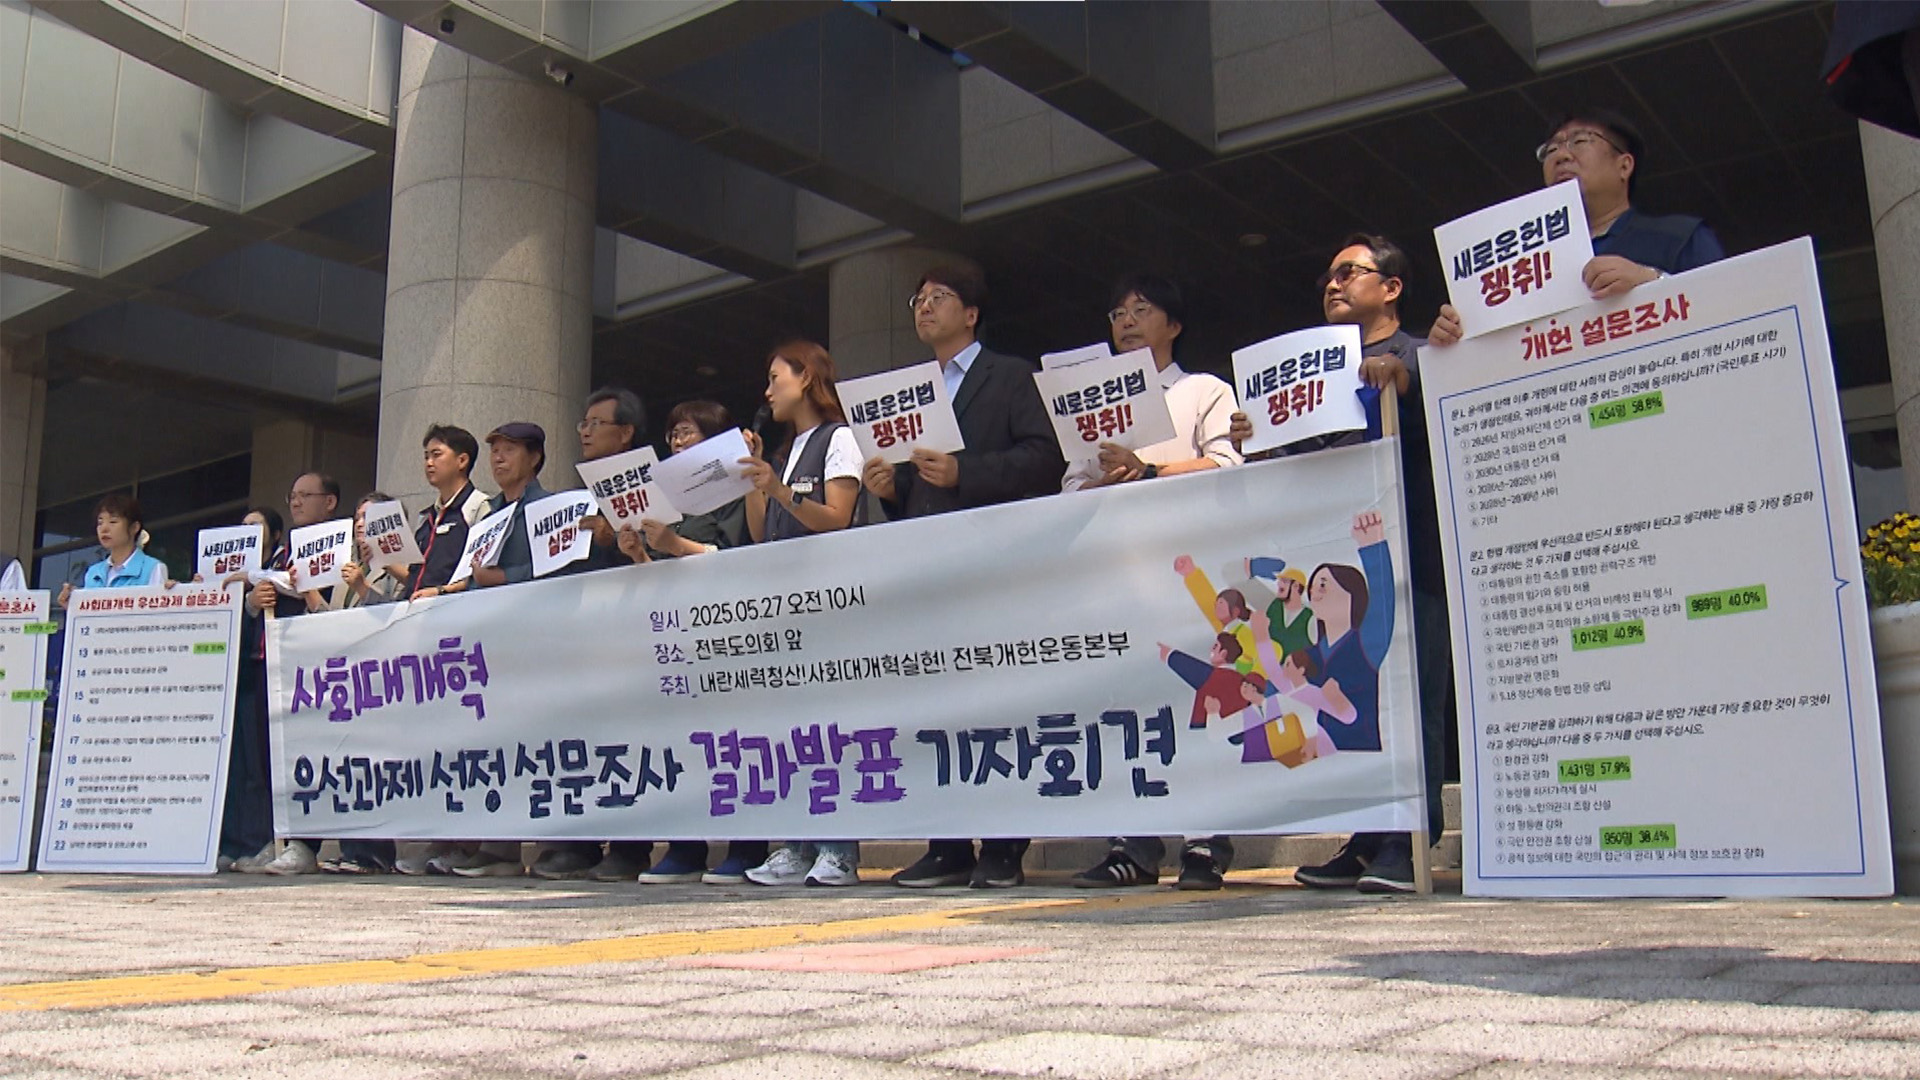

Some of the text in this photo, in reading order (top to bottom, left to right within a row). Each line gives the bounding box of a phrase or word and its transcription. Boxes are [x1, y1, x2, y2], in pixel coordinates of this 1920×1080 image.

[1480, 250, 1552, 307] 쟁취!
[1521, 294, 1690, 361] 개헌 설문조사
[1267, 379, 1323, 426] 쟁취!
[872, 412, 922, 448] 쟁취!
[1075, 404, 1133, 442] 쟁취!
[610, 489, 649, 518] 쟁취!
[365, 513, 403, 537] 사회대개혁
[533, 502, 589, 538] 사회대개혁
[202, 535, 257, 558] 사회대개혁
[297, 531, 345, 559] 사회대개혁
[377, 533, 403, 554] 실현!
[548, 525, 577, 557] 실현!
[214, 554, 245, 574] 실현!
[308, 553, 335, 576] 실현!
[690, 595, 782, 627] 2025.05.27
[787, 590, 823, 614] 오전
[825, 586, 866, 610] 10시
[80, 626, 90, 636] 12
[79, 648, 88, 658] 13
[695, 631, 780, 660] 전북도의회
[784, 629, 802, 651] 앞
[953, 631, 1130, 671] 전북개헌운동본부
[76, 669, 86, 678] 14
[291, 636, 489, 721] 사회대개혁
[74, 691, 84, 700] 15
[72, 714, 82, 723] 16
[70, 736, 80, 744] 17
[67, 755, 77, 764] 18
[293, 704, 1175, 818] 우선과제 선정 설문조사 결과발표 기자회견
[64, 777, 74, 786] 19
[58, 820, 68, 830] 21
[54, 841, 66, 850] 22
